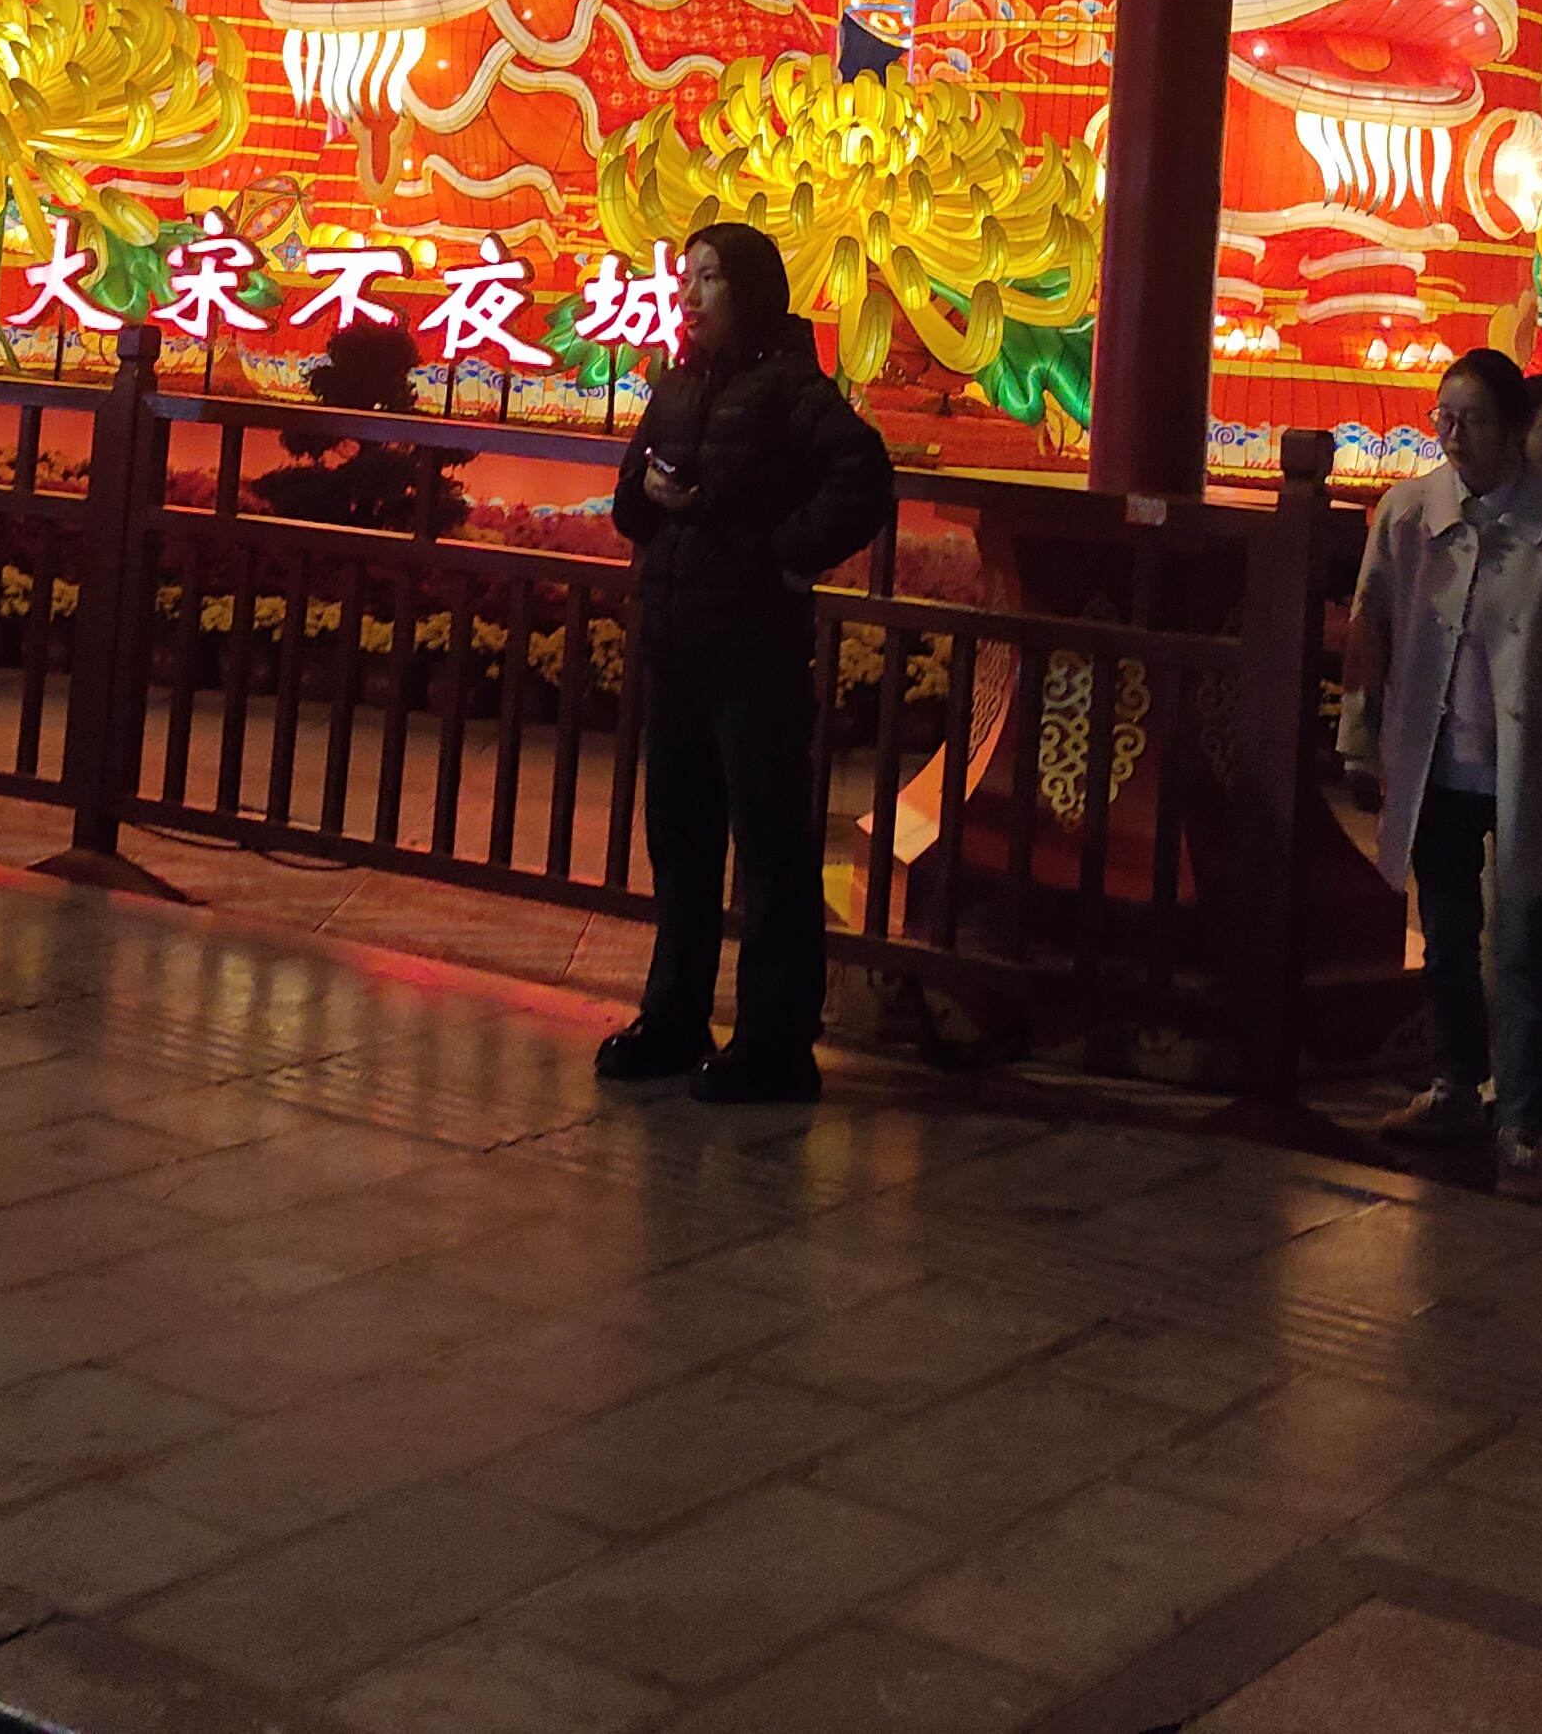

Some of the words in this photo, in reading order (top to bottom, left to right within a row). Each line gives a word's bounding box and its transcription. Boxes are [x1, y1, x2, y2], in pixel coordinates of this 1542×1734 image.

[5, 215, 688, 369] 大宋不夜城
